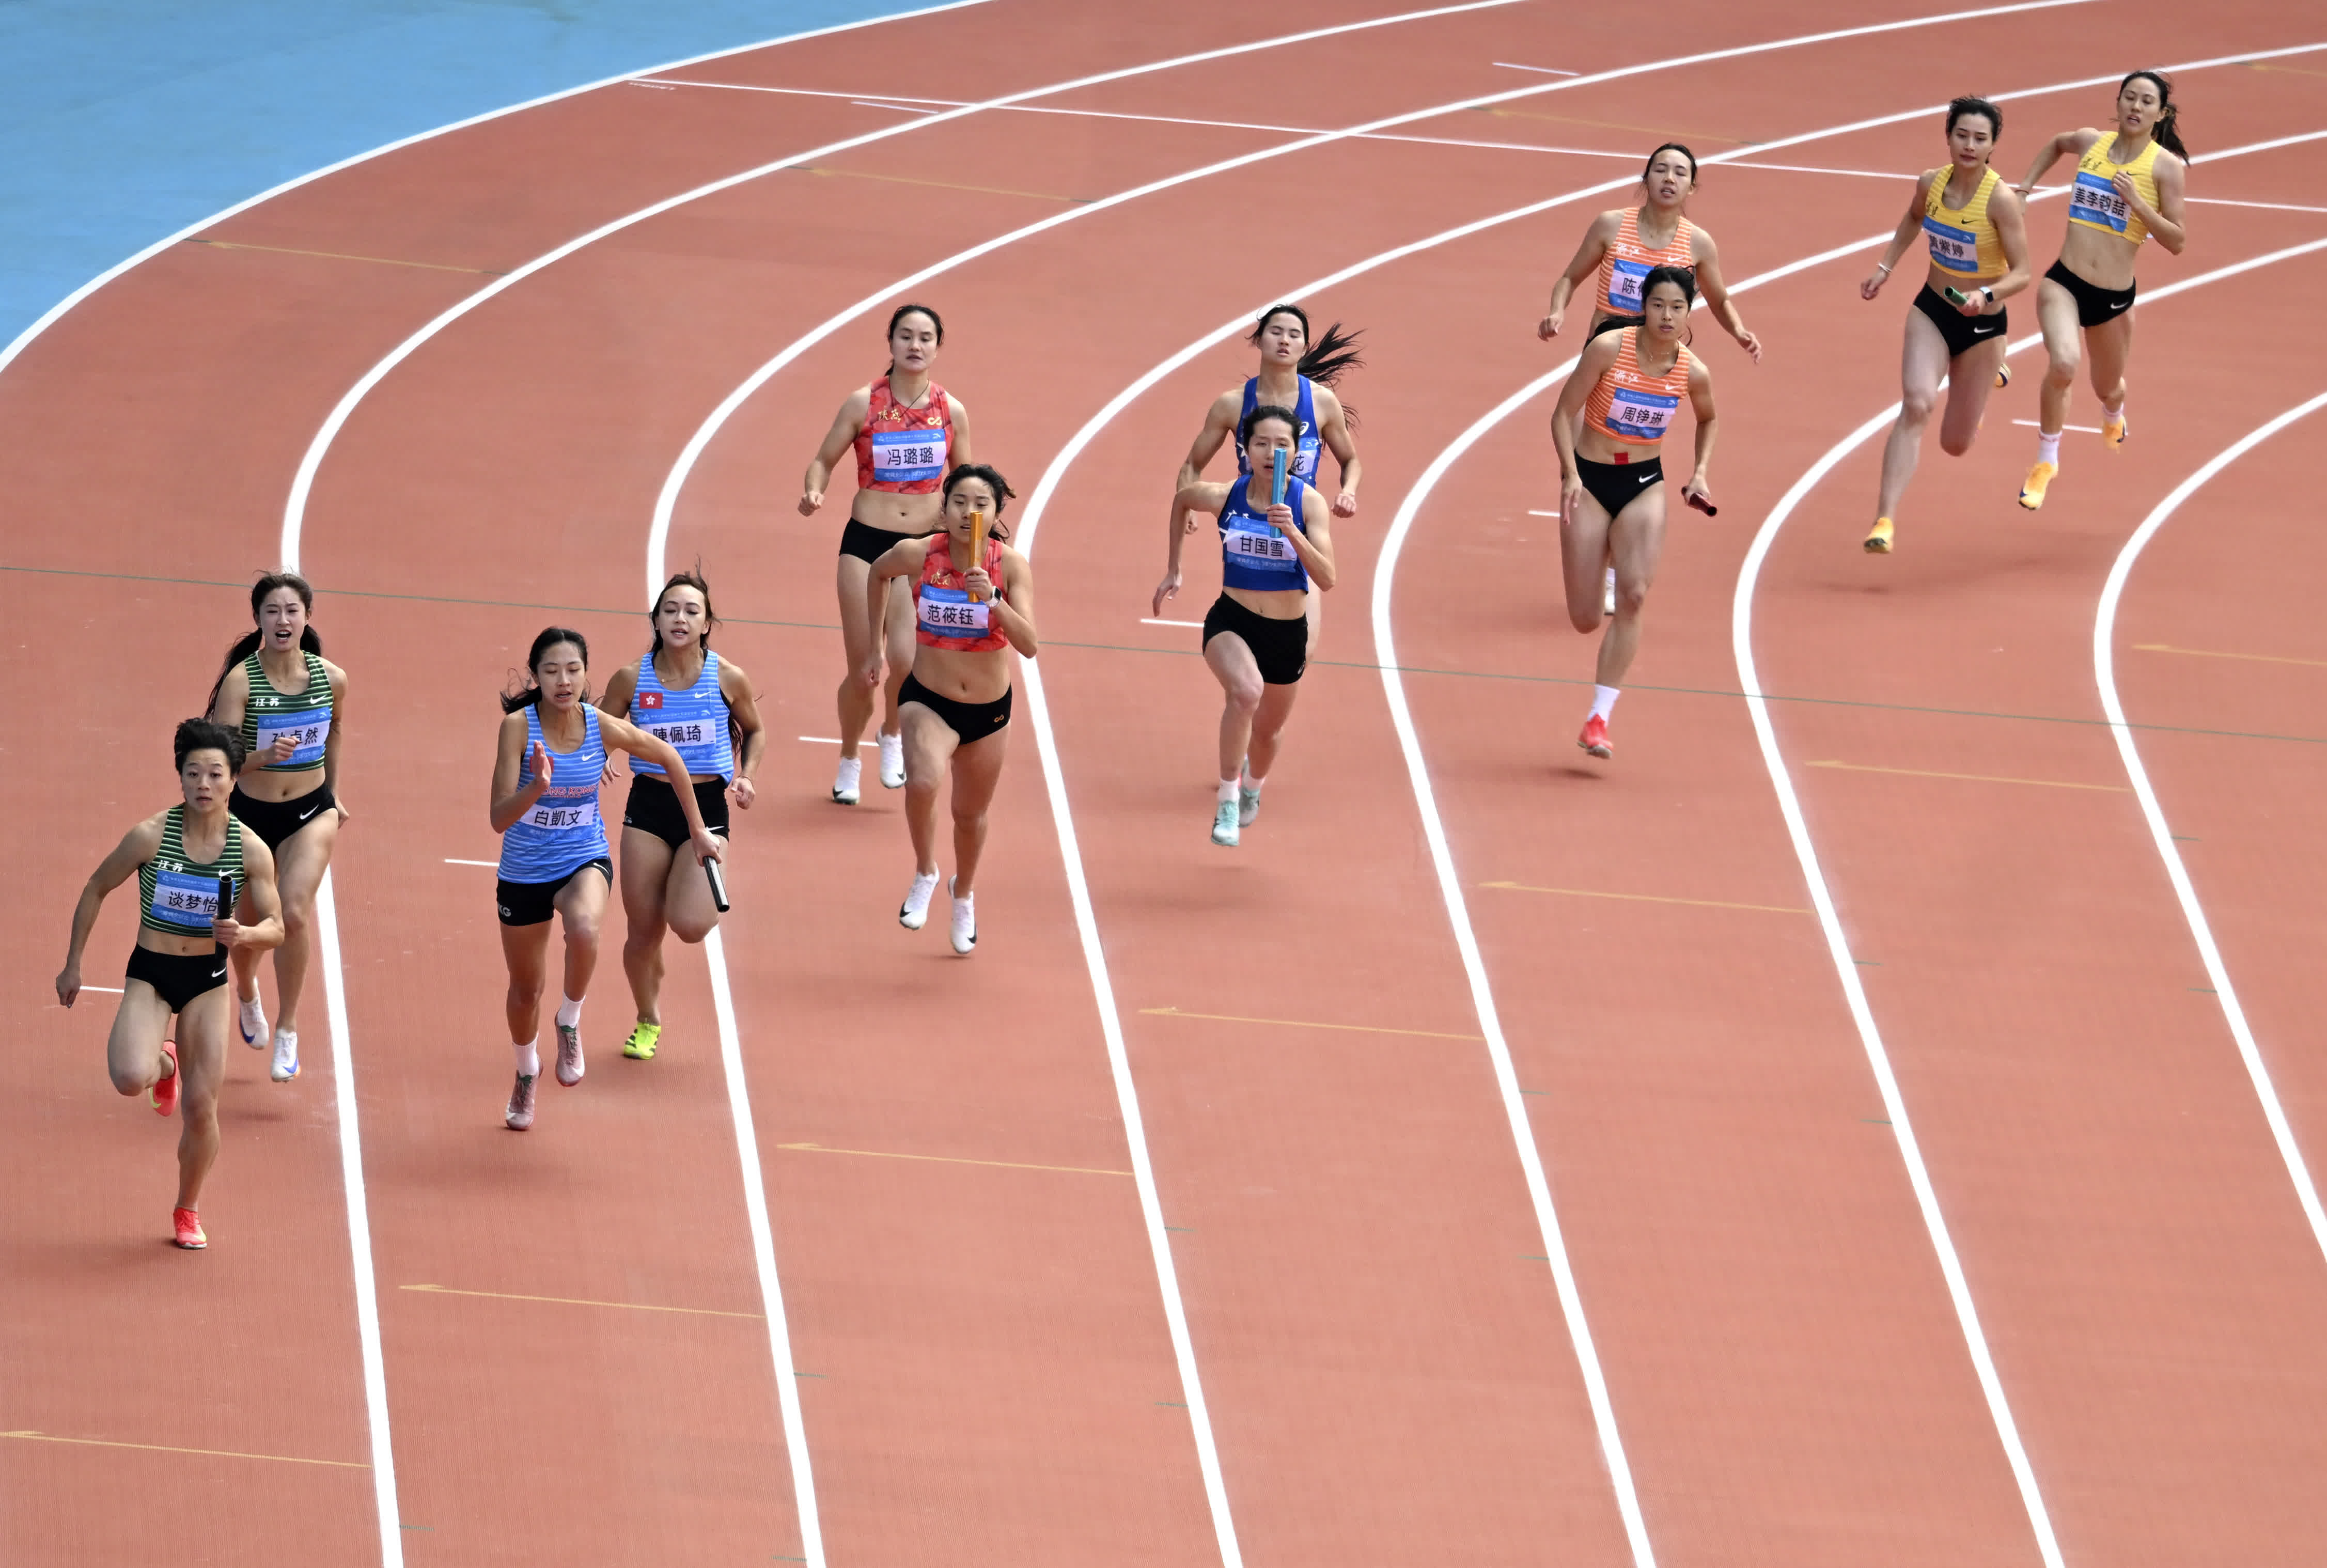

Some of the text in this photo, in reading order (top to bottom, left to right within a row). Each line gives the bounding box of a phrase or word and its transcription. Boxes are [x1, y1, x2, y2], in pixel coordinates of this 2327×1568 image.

[2074, 186, 2127, 217] 姜李韵喆
[1621, 277, 1645, 296] 陈
[1620, 406, 1664, 425] 周铮琳
[887, 446, 933, 466] 冯璐璐
[1240, 535, 1284, 557] 甘国雪
[927, 604, 974, 625] 范筱钰
[255, 698, 279, 707] 江苏
[653, 724, 701, 743] 陳佩琦
[542, 785, 596, 795] ONG KONG
[534, 809, 583, 826] 白凱文
[158, 859, 183, 872] 江苏
[168, 890, 218, 913] 谈梦怡
